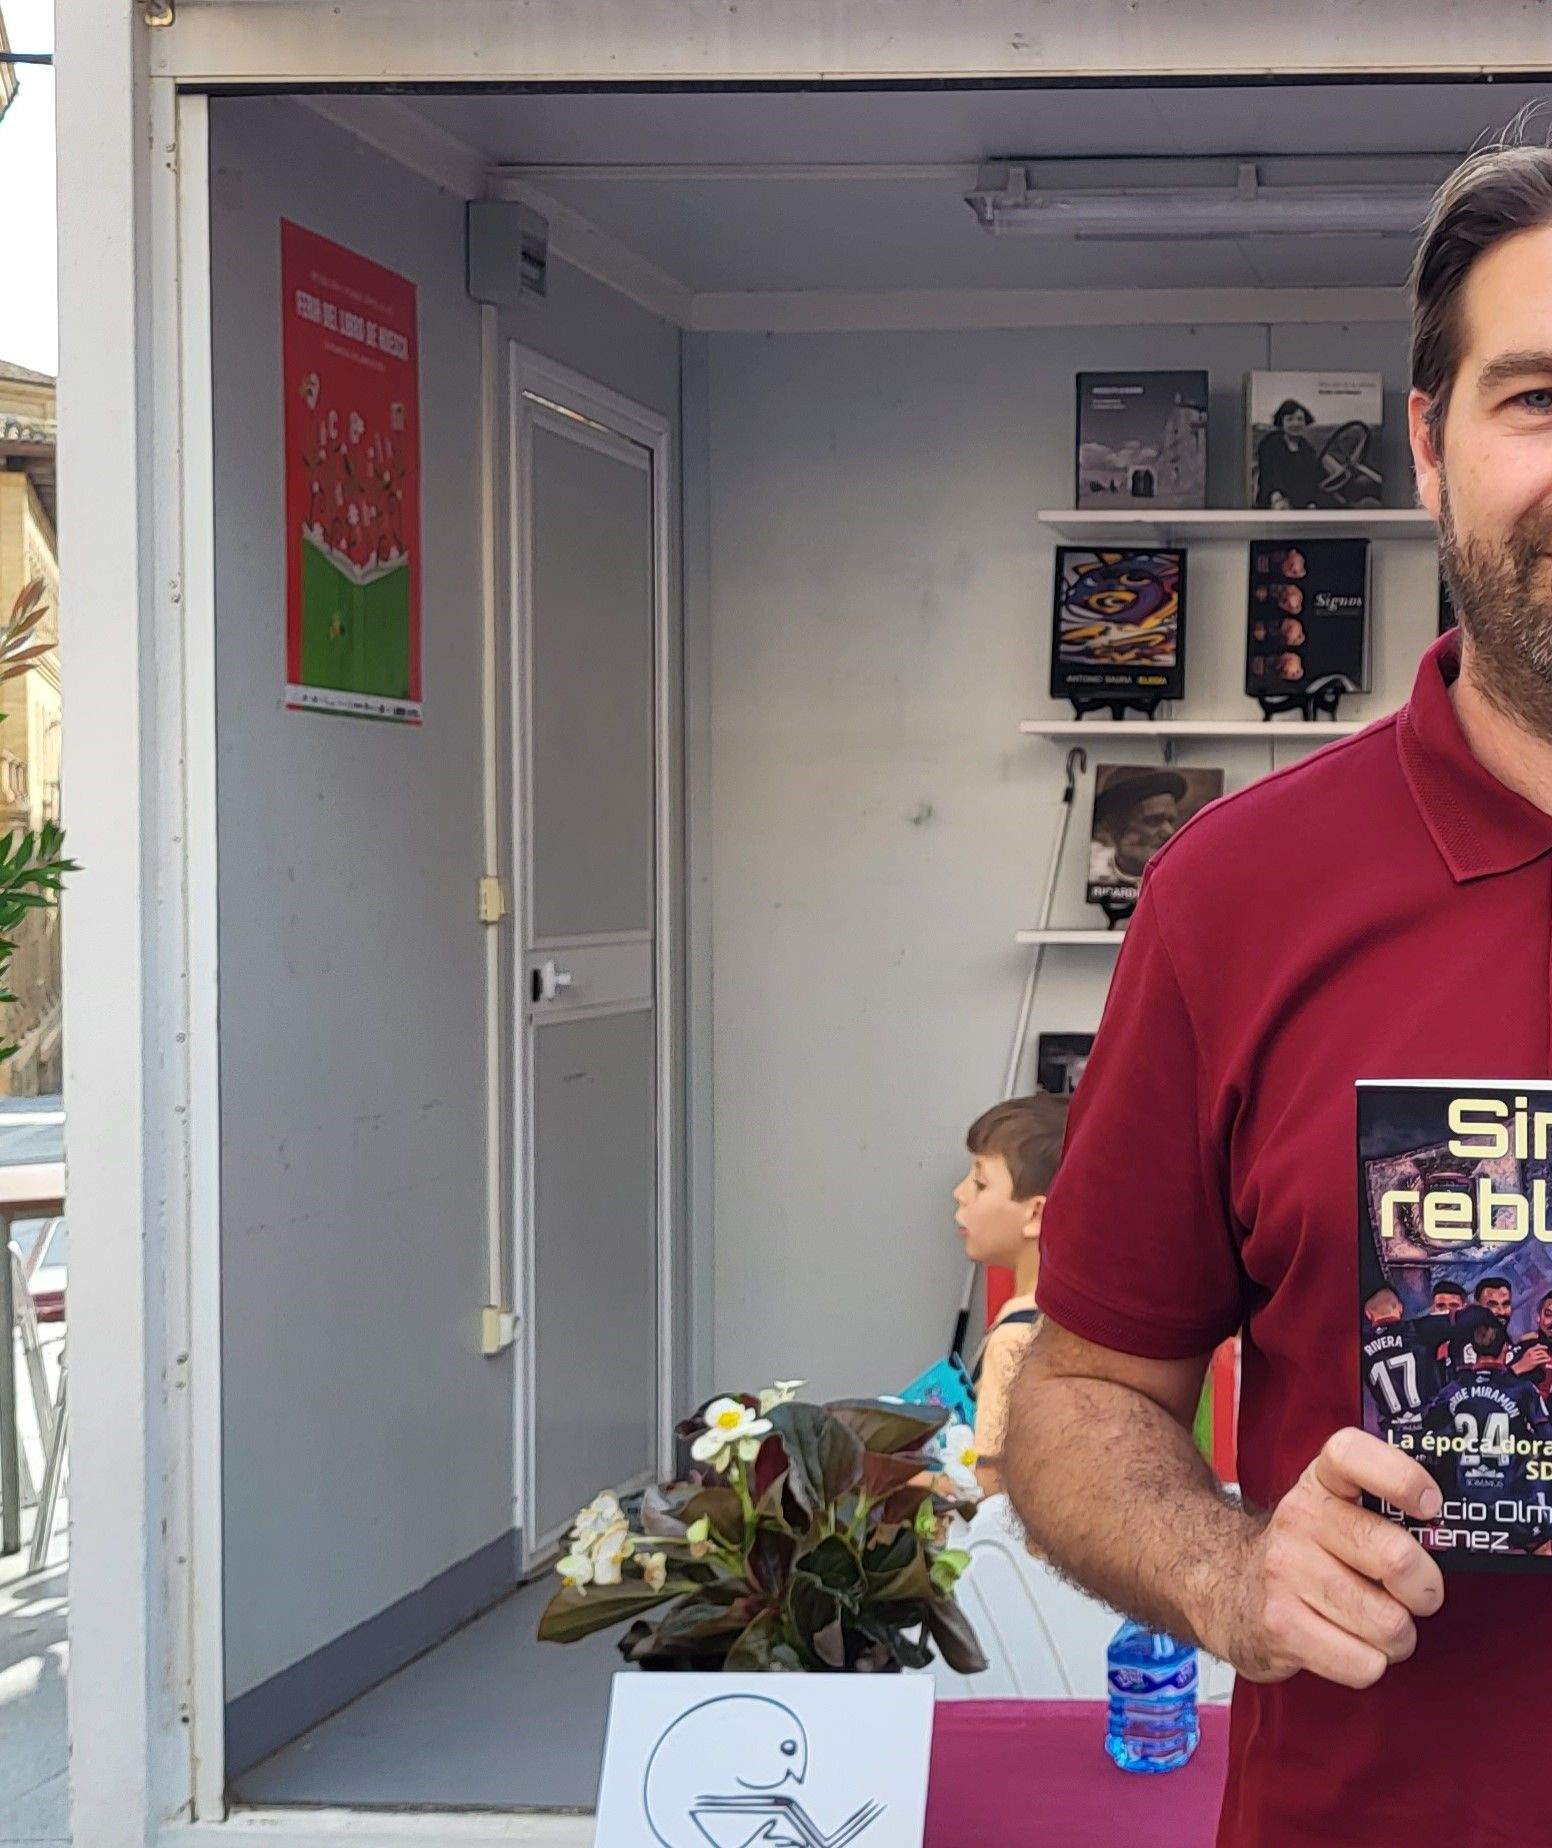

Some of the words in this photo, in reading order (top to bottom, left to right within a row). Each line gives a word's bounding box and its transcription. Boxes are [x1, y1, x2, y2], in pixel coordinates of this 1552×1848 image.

[1315, 592, 1363, 612] Signos
[1363, 1335, 1403, 1357] RIVERA
[1370, 1352, 1421, 1414] 17
[1387, 1429, 1414, 1450] La
[1421, 1430, 1492, 1458] época
[1454, 1412, 1510, 1467] 24
